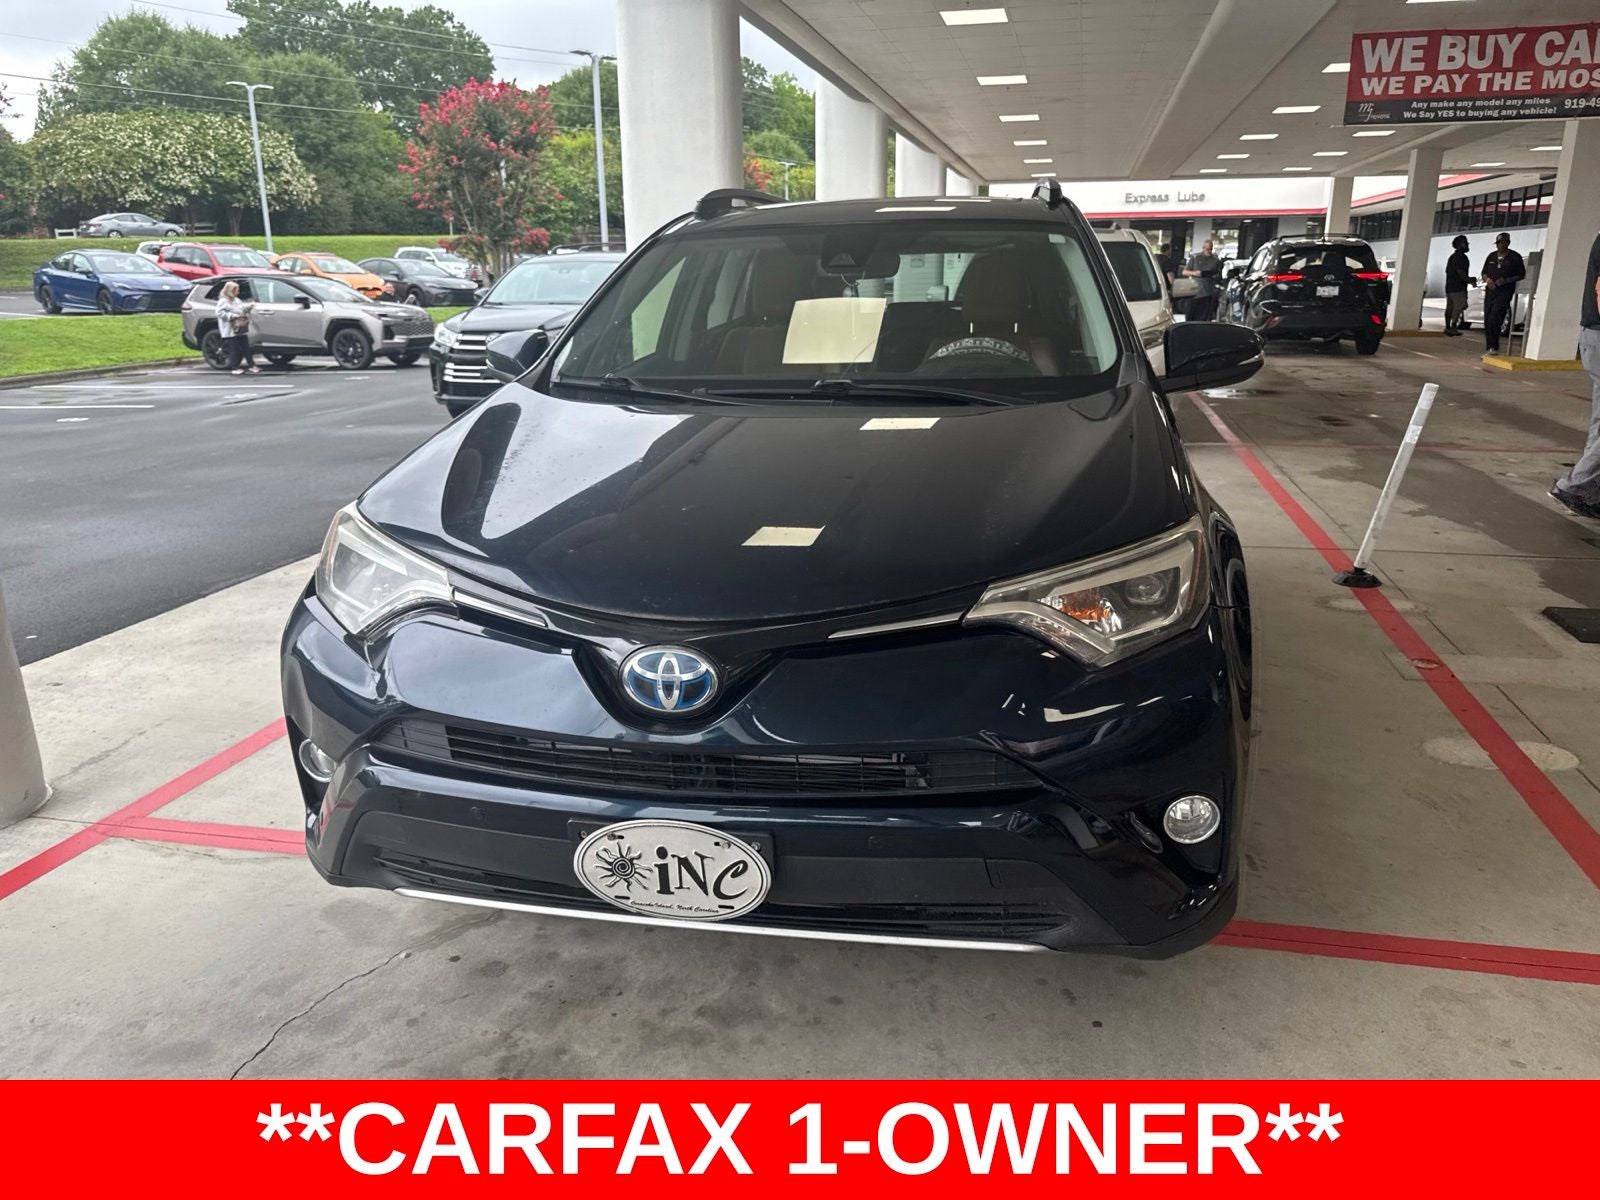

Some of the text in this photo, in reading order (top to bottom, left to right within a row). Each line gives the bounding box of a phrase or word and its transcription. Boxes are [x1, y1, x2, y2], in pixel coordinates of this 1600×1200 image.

[1361, 29, 1600, 73] WE BUY CA
[1361, 76, 1406, 96] WE
[1413, 73, 1470, 94] PAY
[1477, 71, 1534, 92] THE
[1411, 97, 1551, 109] Any make any model any miles
[1403, 111, 1417, 119] We
[1418, 110, 1435, 119] Say
[1455, 109, 1466, 117] to
[1467, 108, 1499, 118] buying
[1500, 108, 1517, 117] any
[1519, 106, 1557, 115] vehicle!
[1125, 191, 1205, 205] Express Lube
